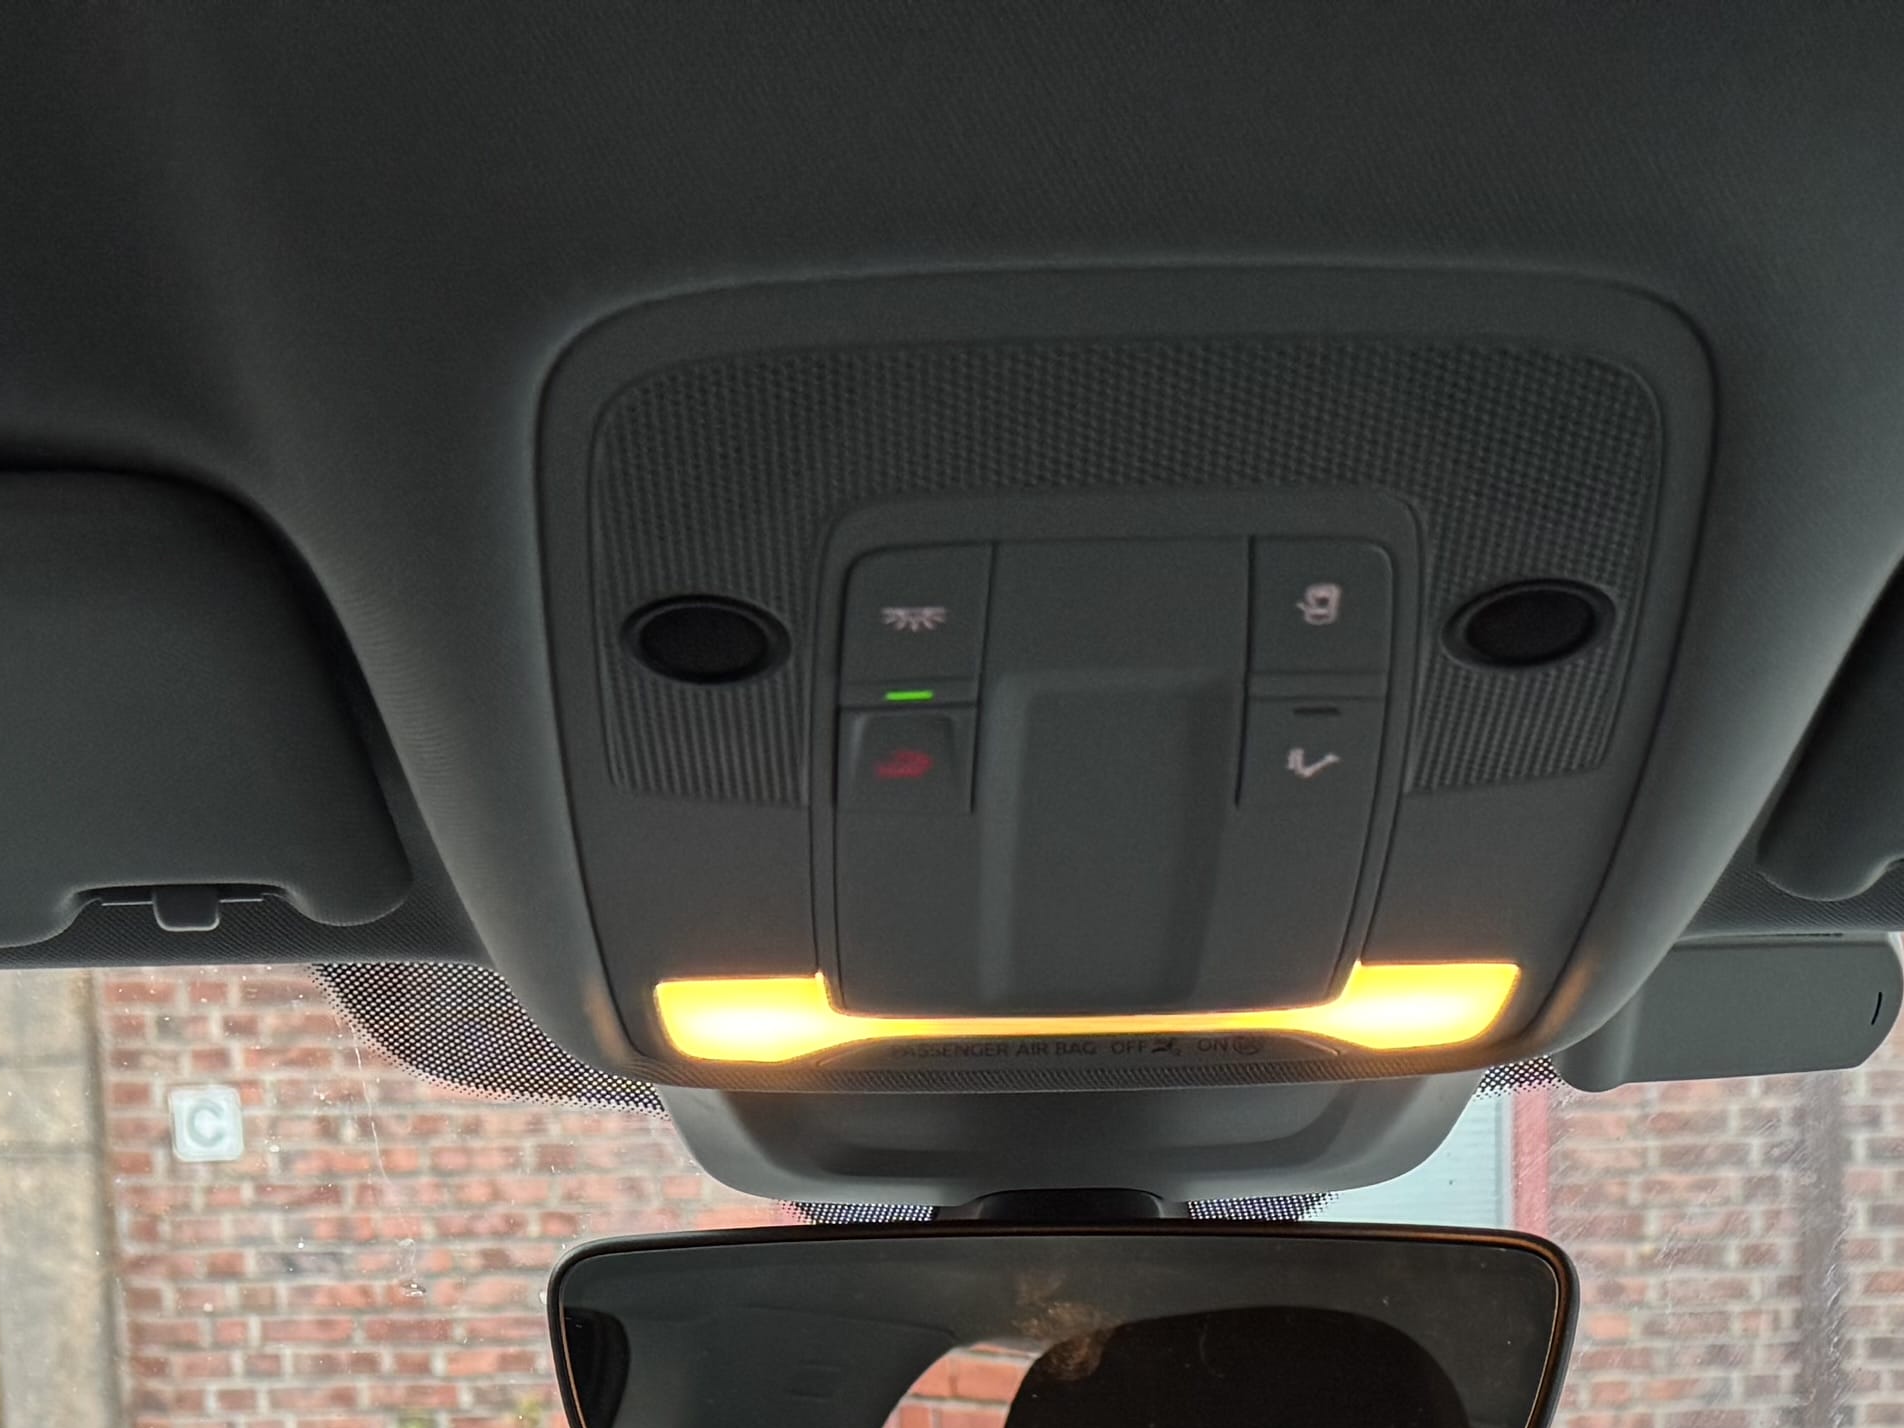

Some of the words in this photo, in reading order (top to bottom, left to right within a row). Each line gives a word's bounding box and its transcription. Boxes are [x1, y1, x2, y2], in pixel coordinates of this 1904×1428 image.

[1016, 1041, 1048, 1057] AIR
[1056, 1041, 1096, 1056] BAG
[1112, 1039, 1147, 1056] OFF
[1199, 1038, 1229, 1053] ON
